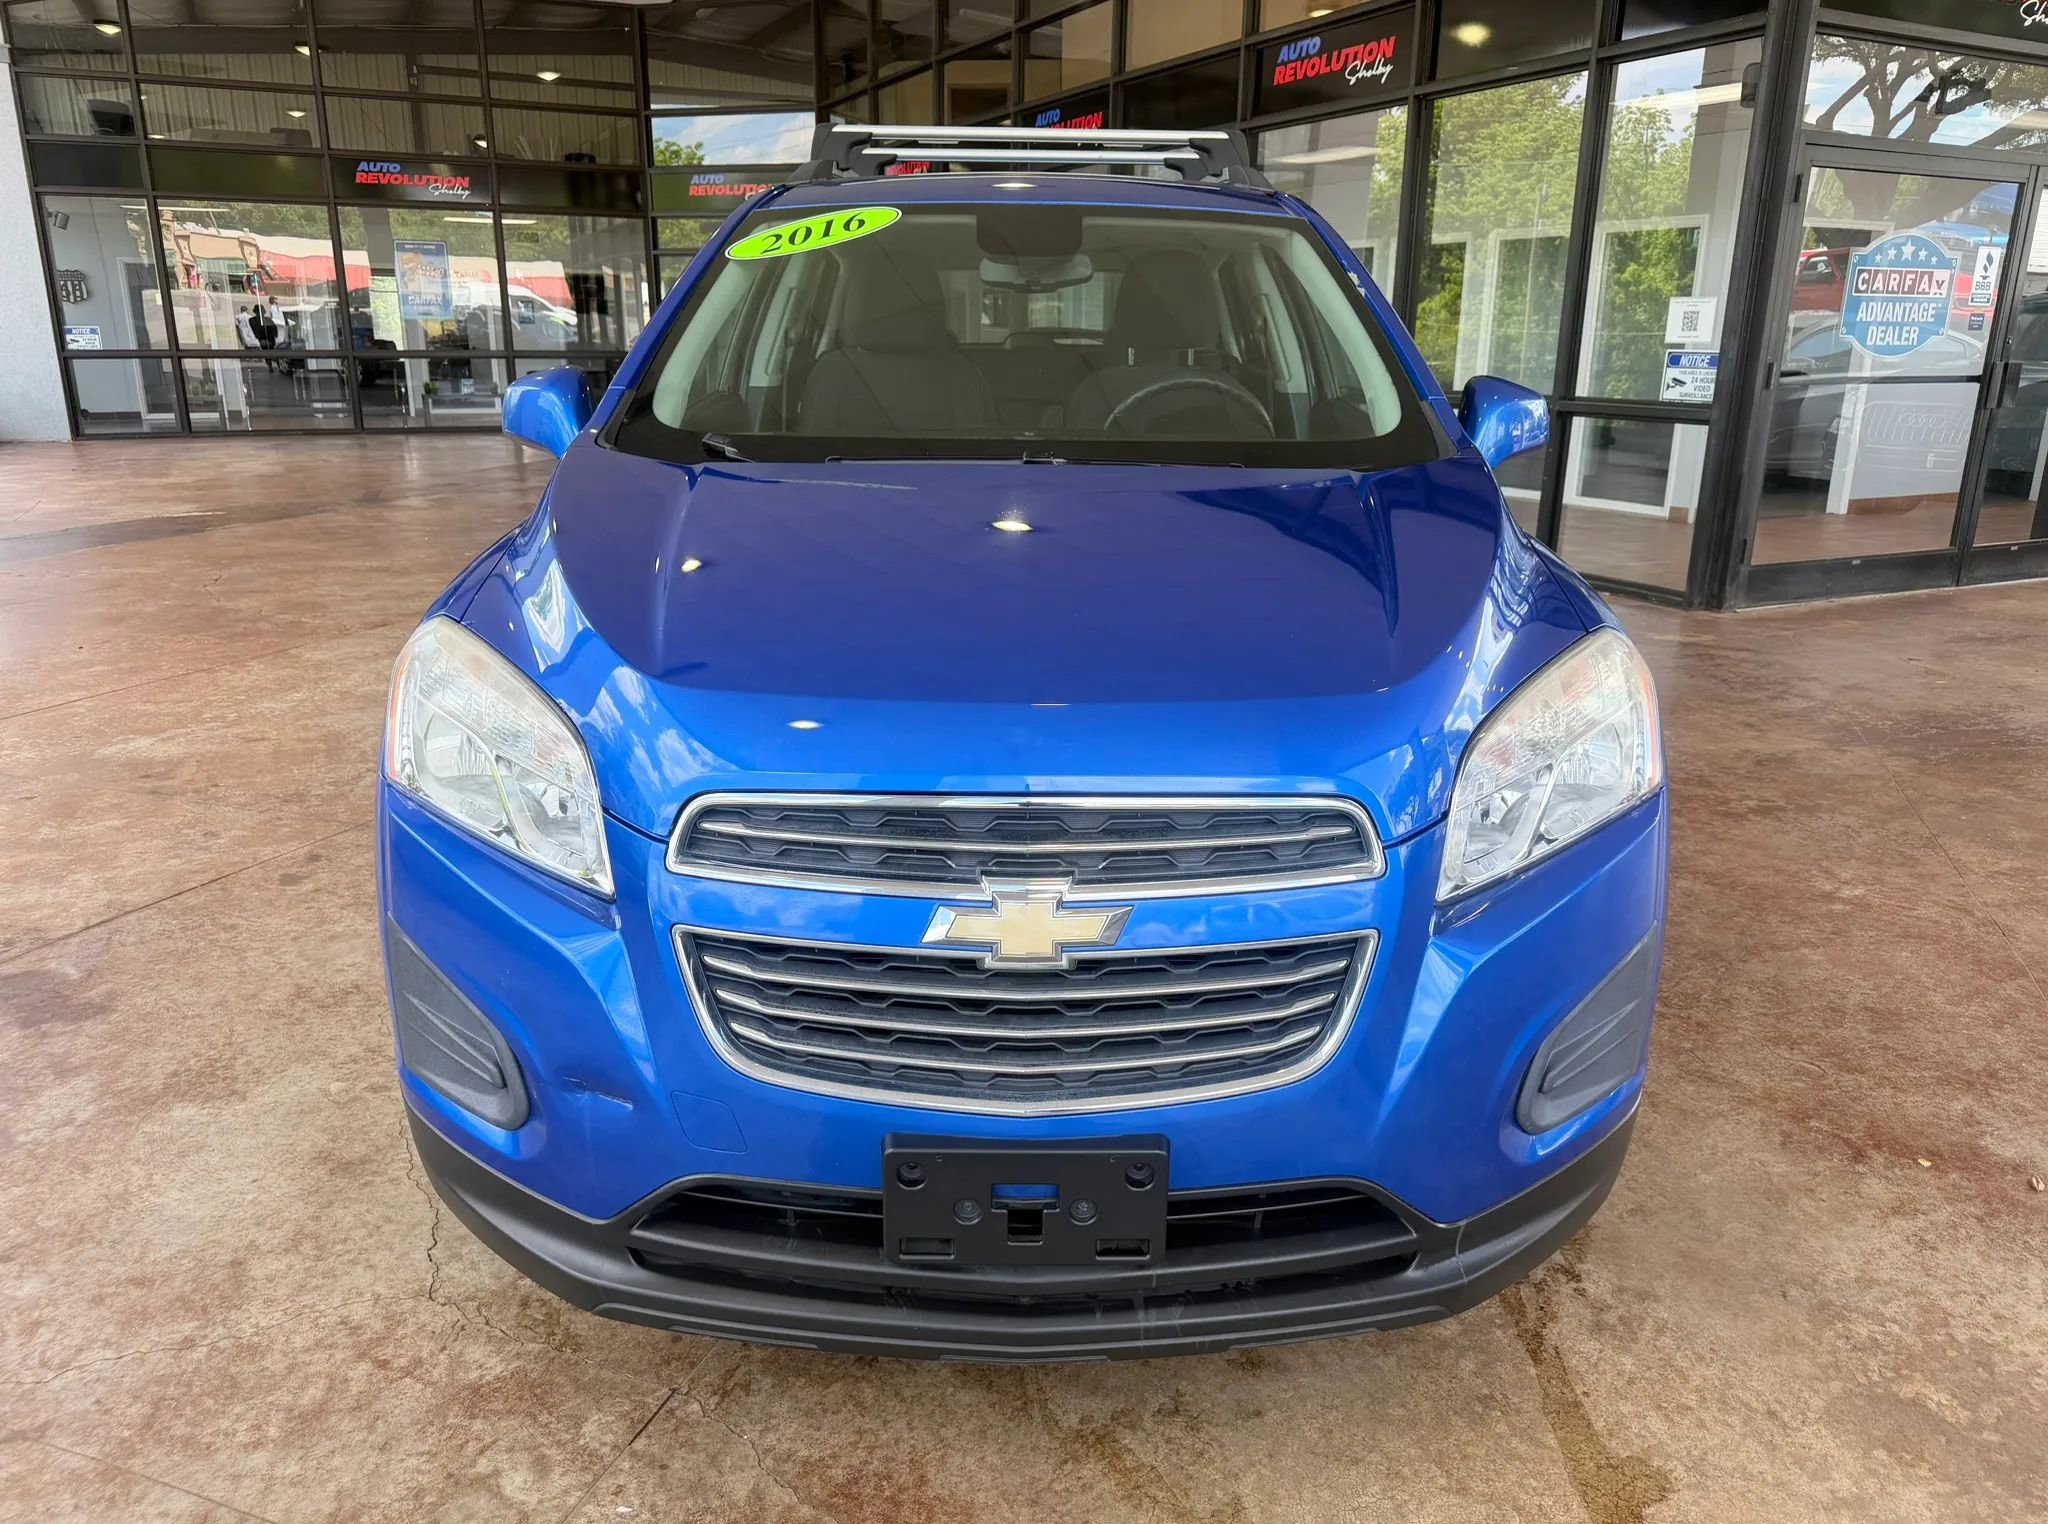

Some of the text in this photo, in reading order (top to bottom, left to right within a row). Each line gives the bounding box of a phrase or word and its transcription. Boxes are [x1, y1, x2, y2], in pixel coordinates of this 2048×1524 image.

[1277, 36, 1321, 63] AUTO
[1273, 36, 1396, 86] REVOLUTION
[1345, 54, 1394, 85] Shelby
[1035, 108, 1061, 127] AUTO
[357, 161, 401, 172] AUTO
[355, 172, 470, 188] REVOLUTION
[690, 174, 725, 184] AUTO
[428, 183, 471, 199] Shelby
[689, 184, 773, 196] REVOLUTIO
[760, 211, 866, 255] 2016
[1857, 270, 1946, 295] CARFAX
[1856, 302, 1937, 323] ADVANTAGE
[1866, 326, 1920, 345] DEALER
[1680, 354, 1711, 367] NOTICE
